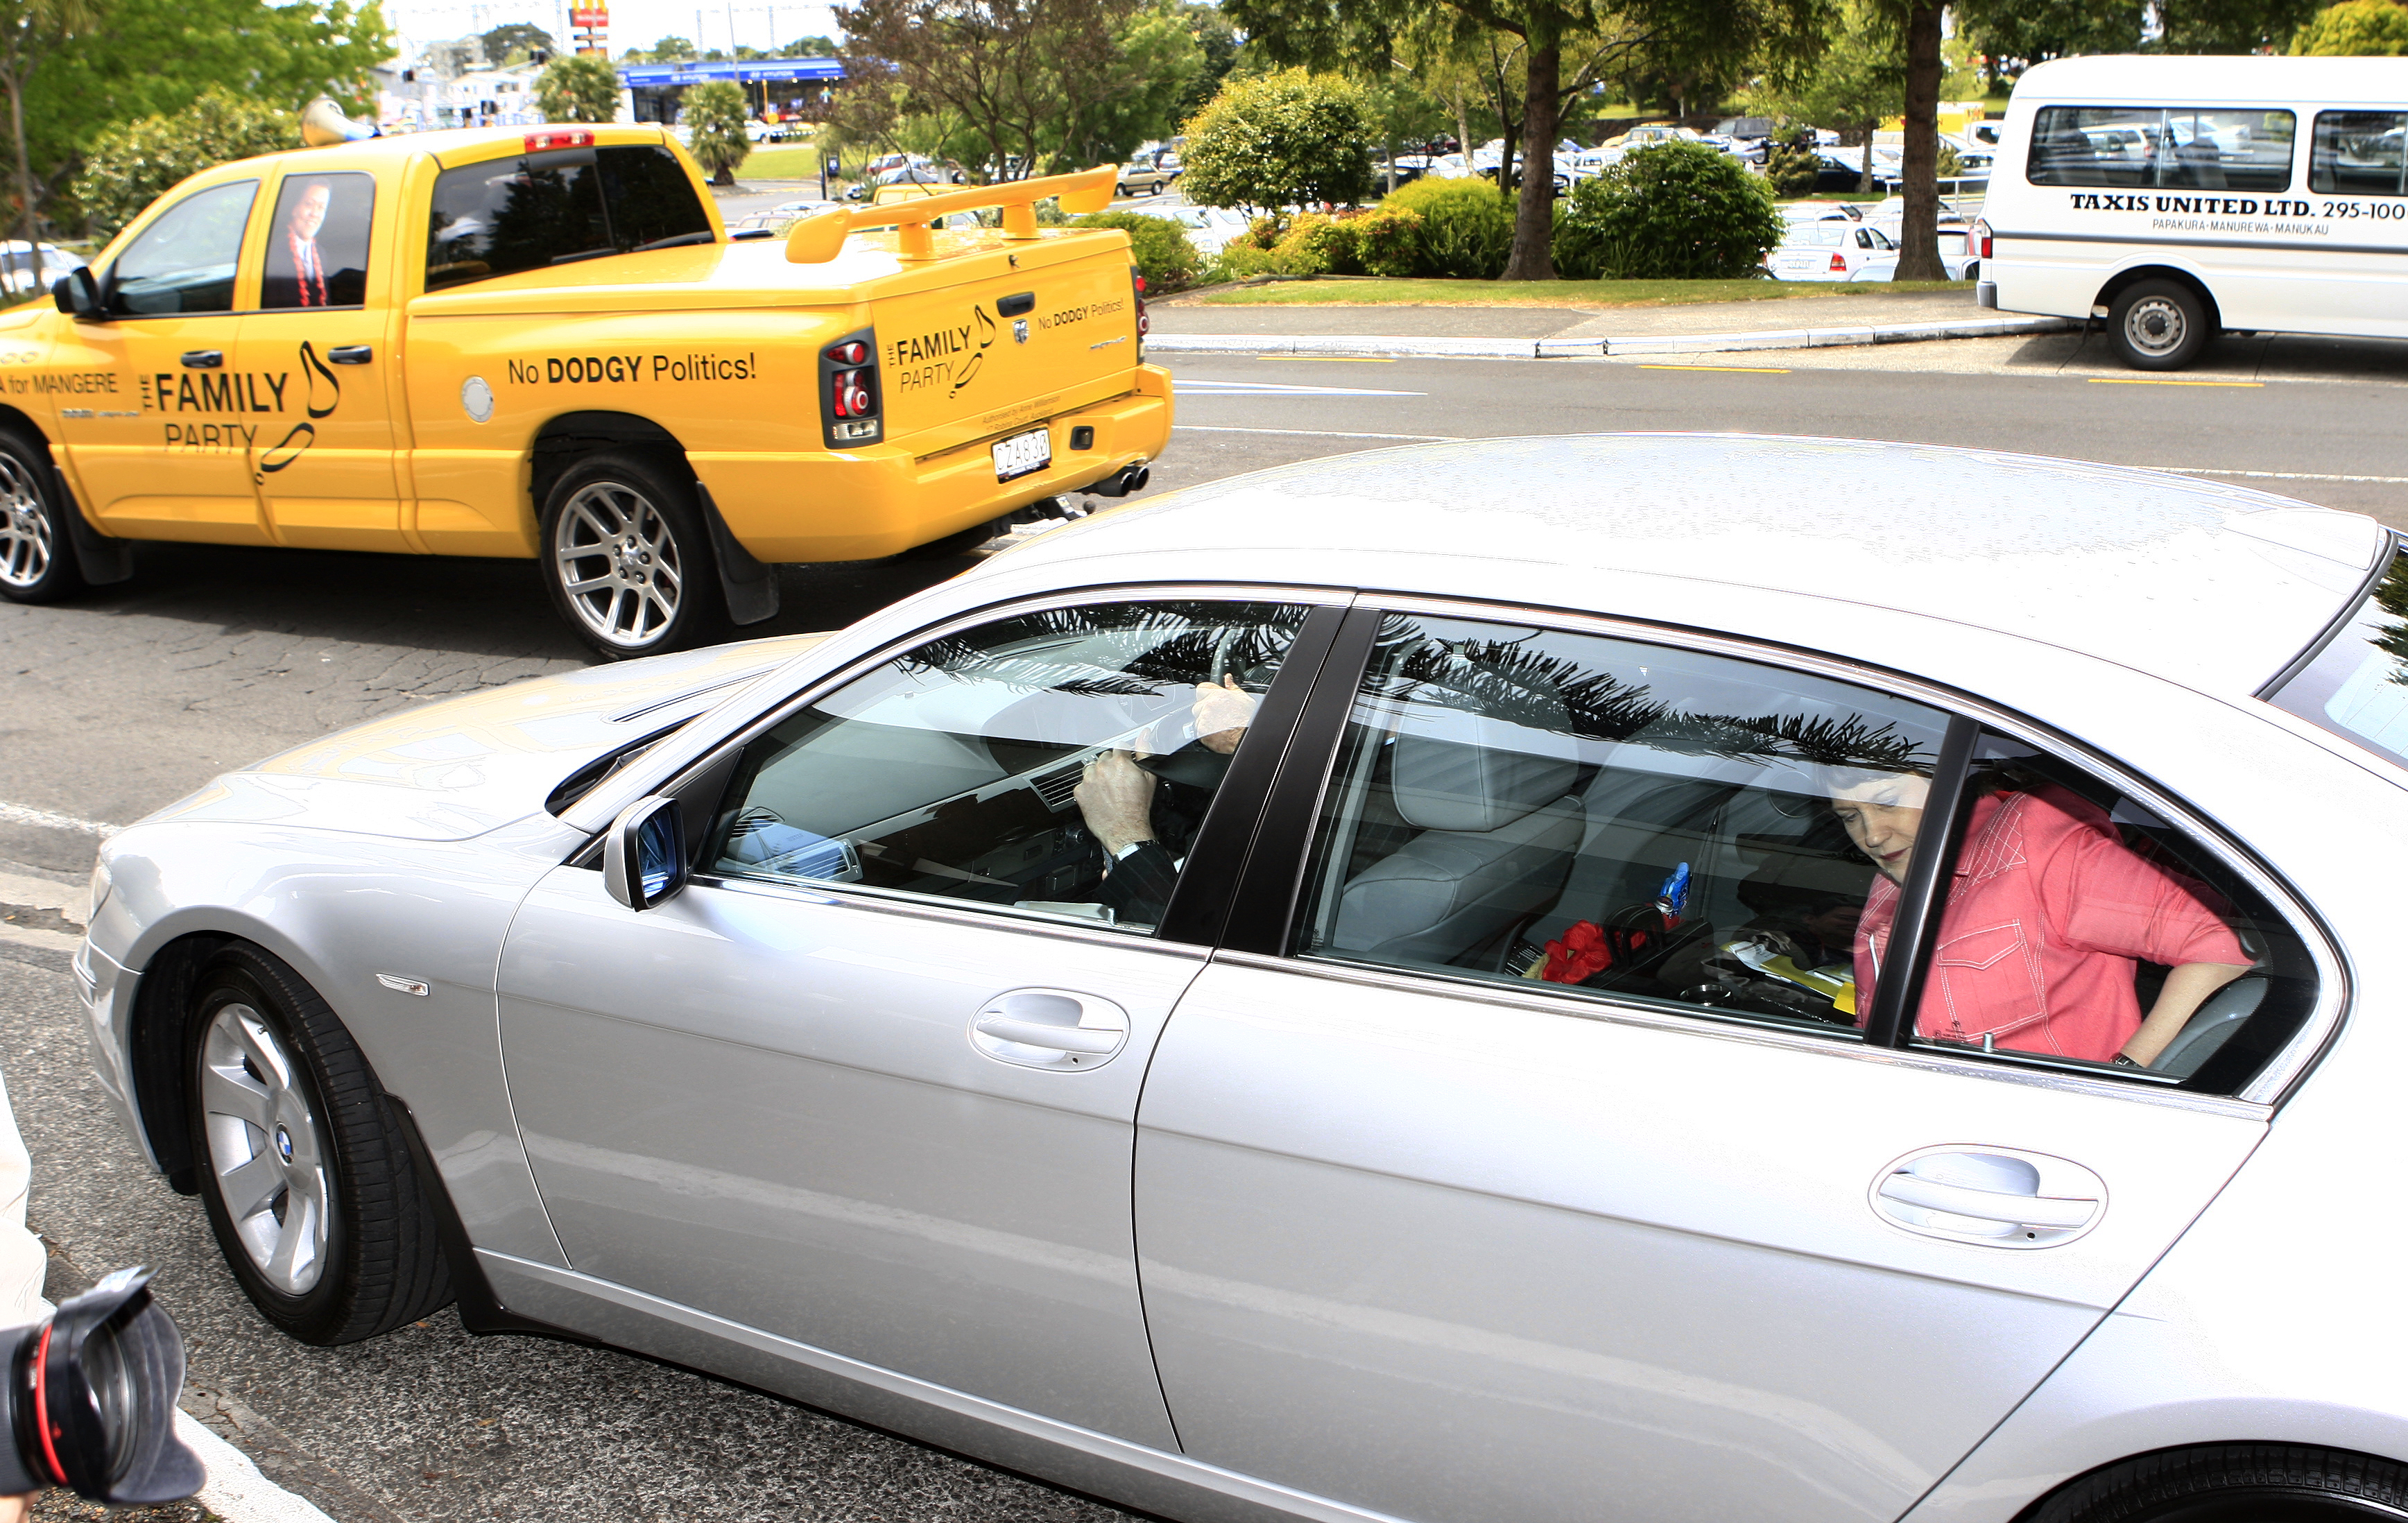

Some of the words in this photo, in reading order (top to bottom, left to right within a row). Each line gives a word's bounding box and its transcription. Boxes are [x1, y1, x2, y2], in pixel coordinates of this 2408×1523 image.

[2070, 193, 2149, 211] TAXIS
[2156, 196, 2258, 215] UNITED
[2264, 199, 2316, 216] LTD.
[2323, 201, 2408, 220] 295-100
[1038, 317, 1051, 330] No
[1054, 306, 1089, 327] DODGY
[1091, 298, 1124, 317] Politics!
[887, 343, 896, 368] THE
[897, 325, 971, 366] FAMILY
[8, 374, 29, 394] for
[32, 373, 119, 394] MANGERE
[508, 358, 539, 384] No
[547, 355, 643, 384] DODGY
[653, 352, 757, 381] Politics!
[900, 360, 954, 393] PARTY
[139, 374, 153, 411] THE
[155, 372, 289, 412] FAMILY
[164, 422, 259, 454] PARTY
